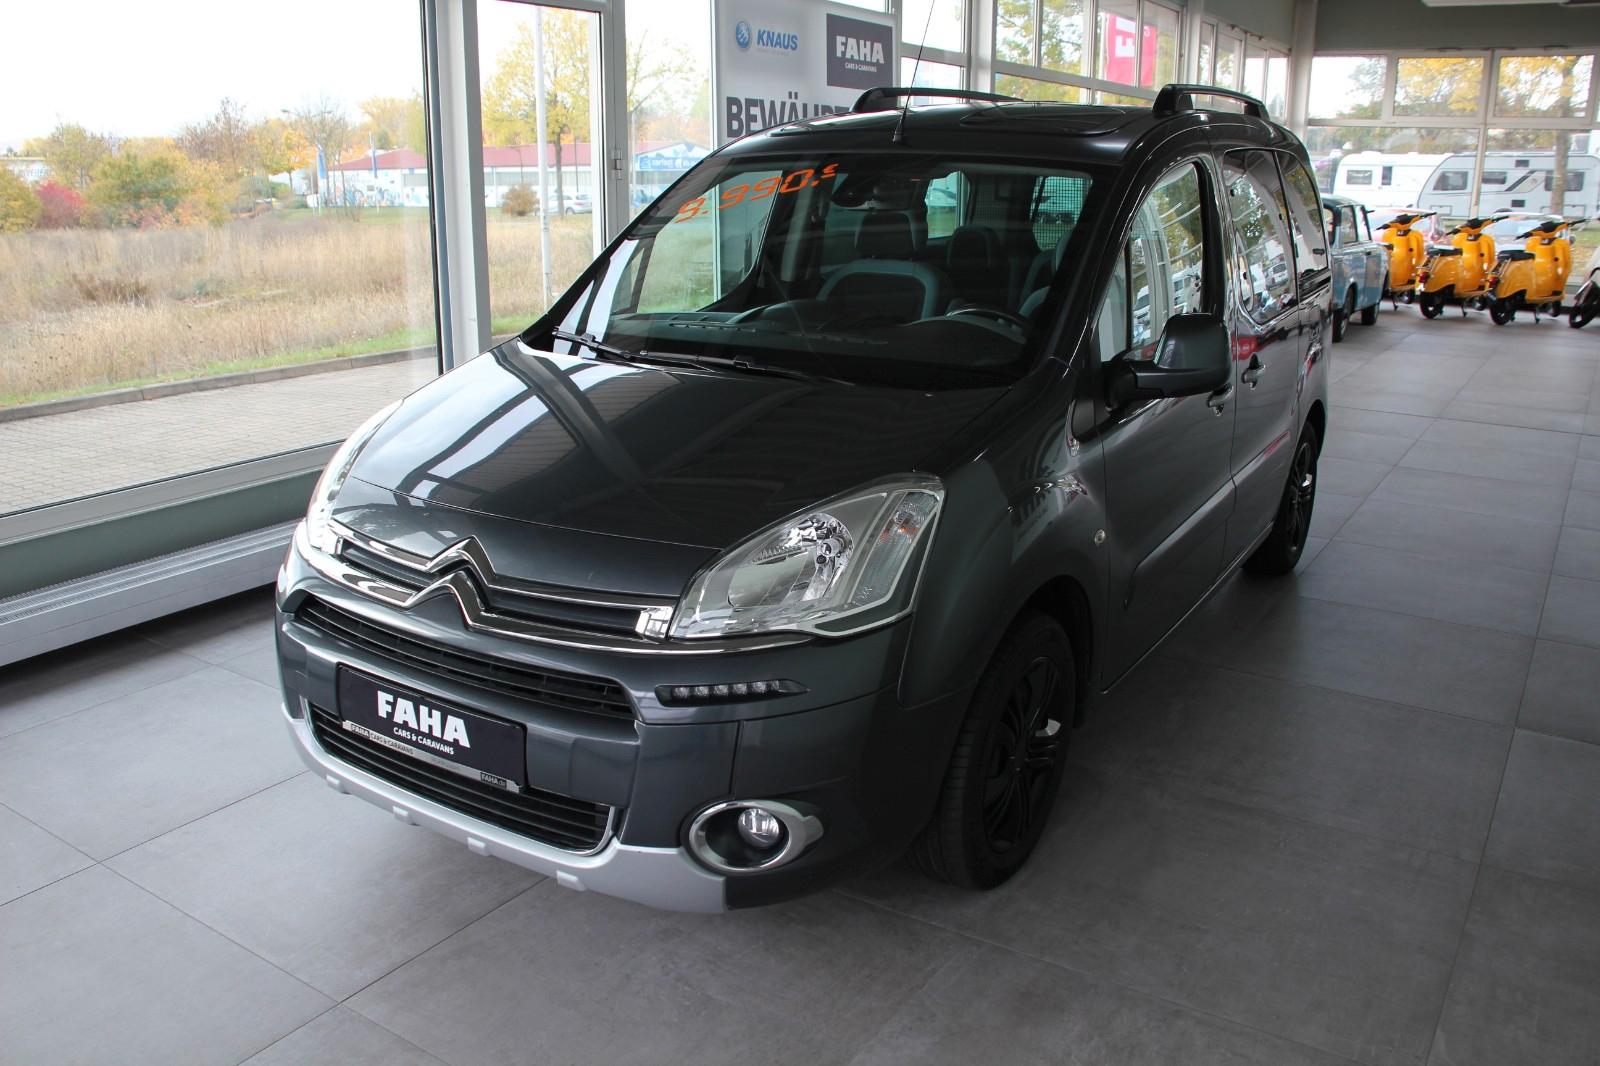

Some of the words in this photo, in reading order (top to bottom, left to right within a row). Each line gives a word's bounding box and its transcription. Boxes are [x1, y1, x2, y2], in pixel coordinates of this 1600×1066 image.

[757, 29, 798, 50] KNAUS
[836, 35, 884, 64] FAHA
[377, 690, 471, 748] FAHA
[393, 727, 411, 739] CARS
[411, 733, 417, 741] &
[417, 736, 454, 755] CARAVANS
